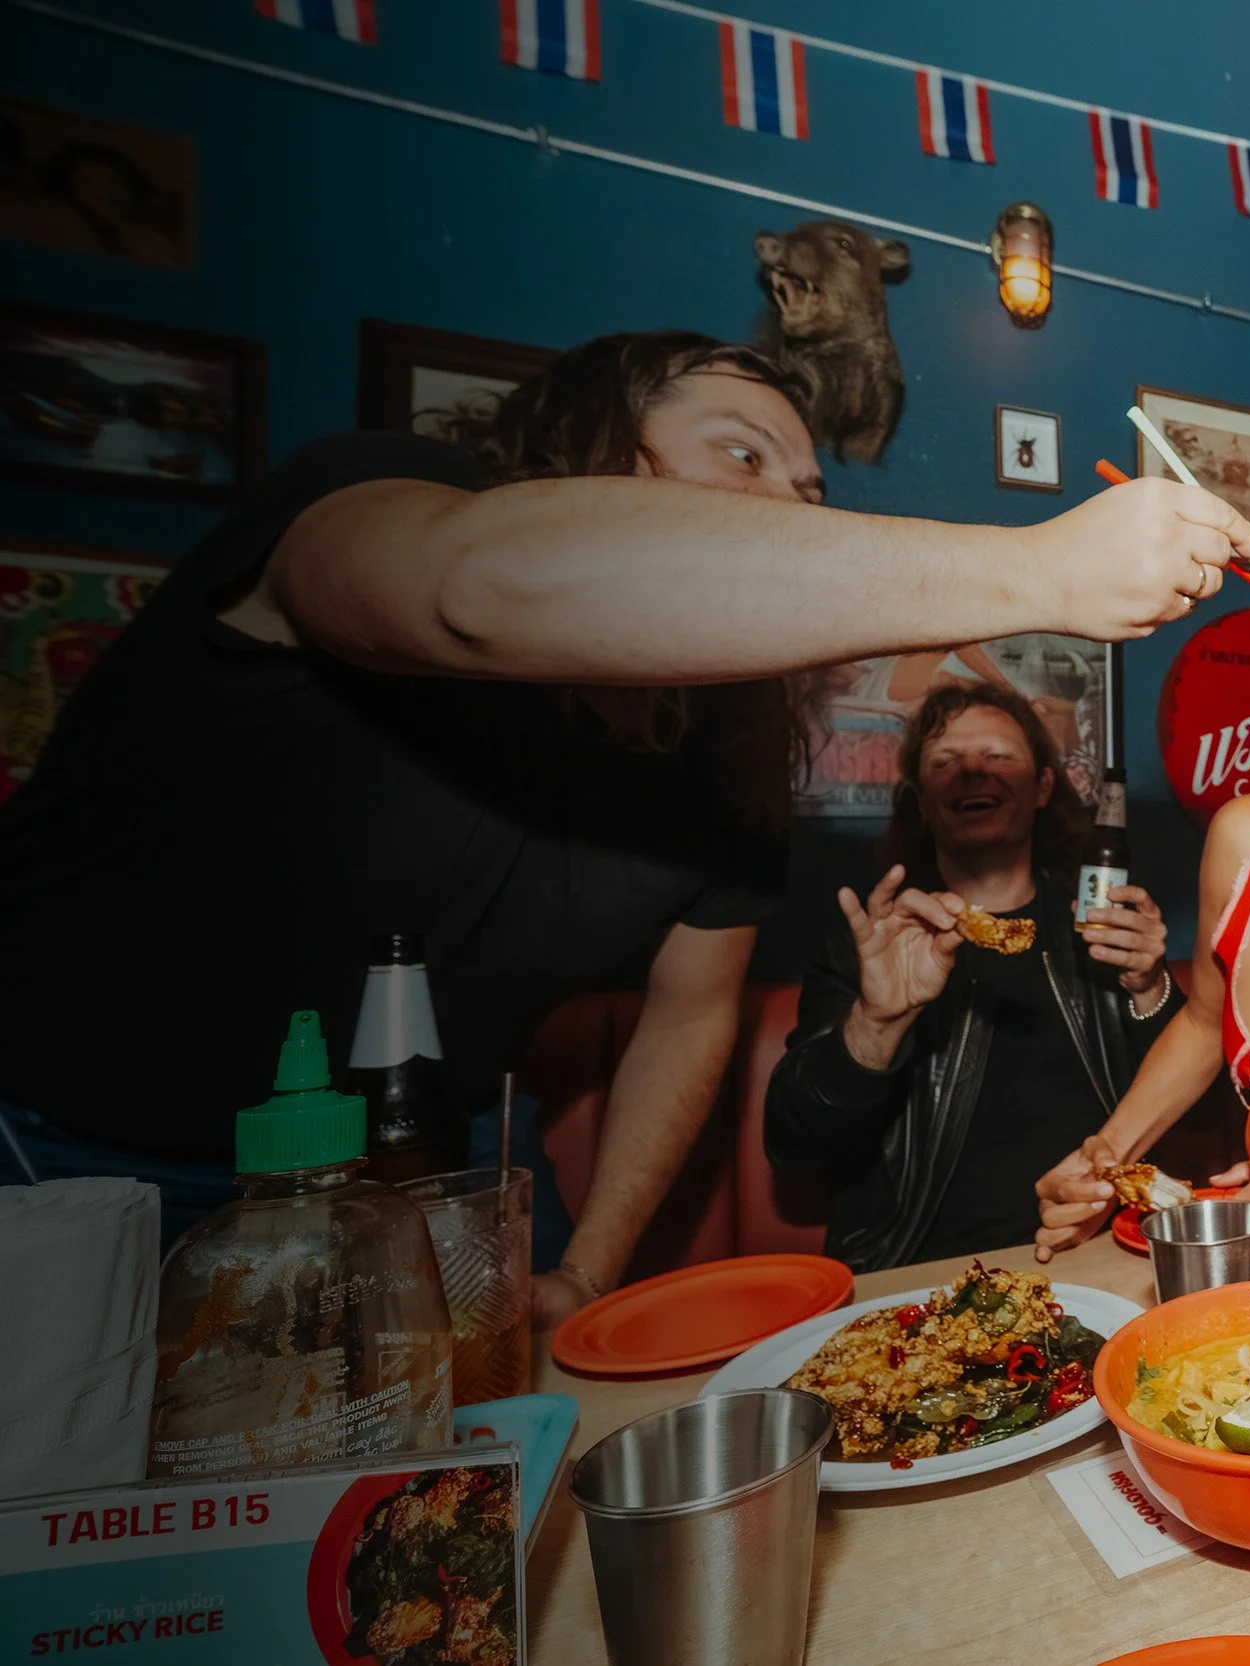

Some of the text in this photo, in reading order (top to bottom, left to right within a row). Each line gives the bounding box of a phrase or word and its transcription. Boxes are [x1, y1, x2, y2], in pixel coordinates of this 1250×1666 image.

[172, 1464, 203, 1476] FROM
[272, 1443, 298, 1459] AND
[357, 1411, 389, 1431] ITEMS
[178, 1445, 236, 1461] REMOVING
[308, 1421, 330, 1435] THE
[331, 1403, 381, 1428] PRODUCT
[382, 1392, 409, 1410] AWAY
[211, 1433, 236, 1446] AND
[341, 1396, 369, 1414] WITH
[370, 1379, 411, 1401] CAUTION
[41, 1492, 270, 1547] TABLE B15
[30, 1609, 225, 1656] STICKY RICE
